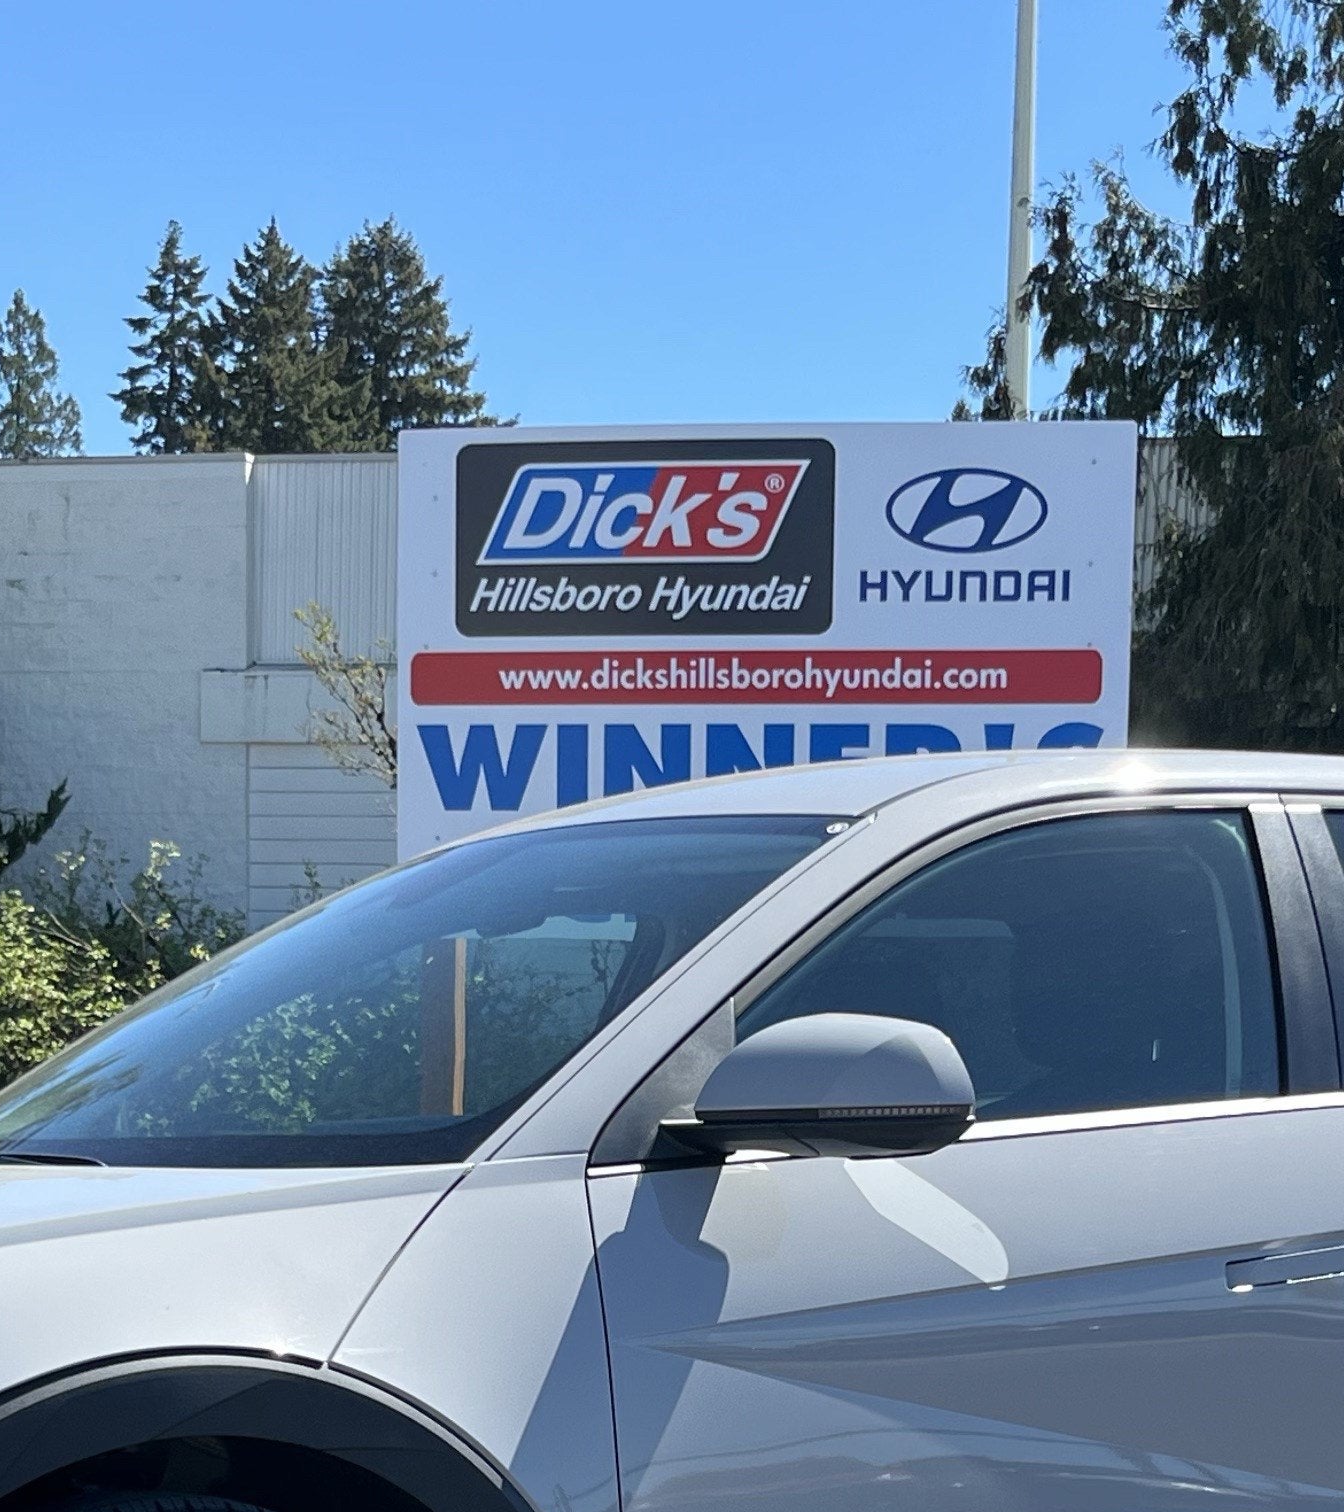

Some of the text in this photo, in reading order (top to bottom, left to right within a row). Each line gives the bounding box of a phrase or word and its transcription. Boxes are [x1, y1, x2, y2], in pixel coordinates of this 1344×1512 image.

[501, 471, 768, 550] Dick's
[468, 574, 812, 621] Hillsboro Hyundai
[859, 568, 1072, 603] HYUNDAI
[498, 657, 1008, 698] www.dickshillsborohyundai.com
